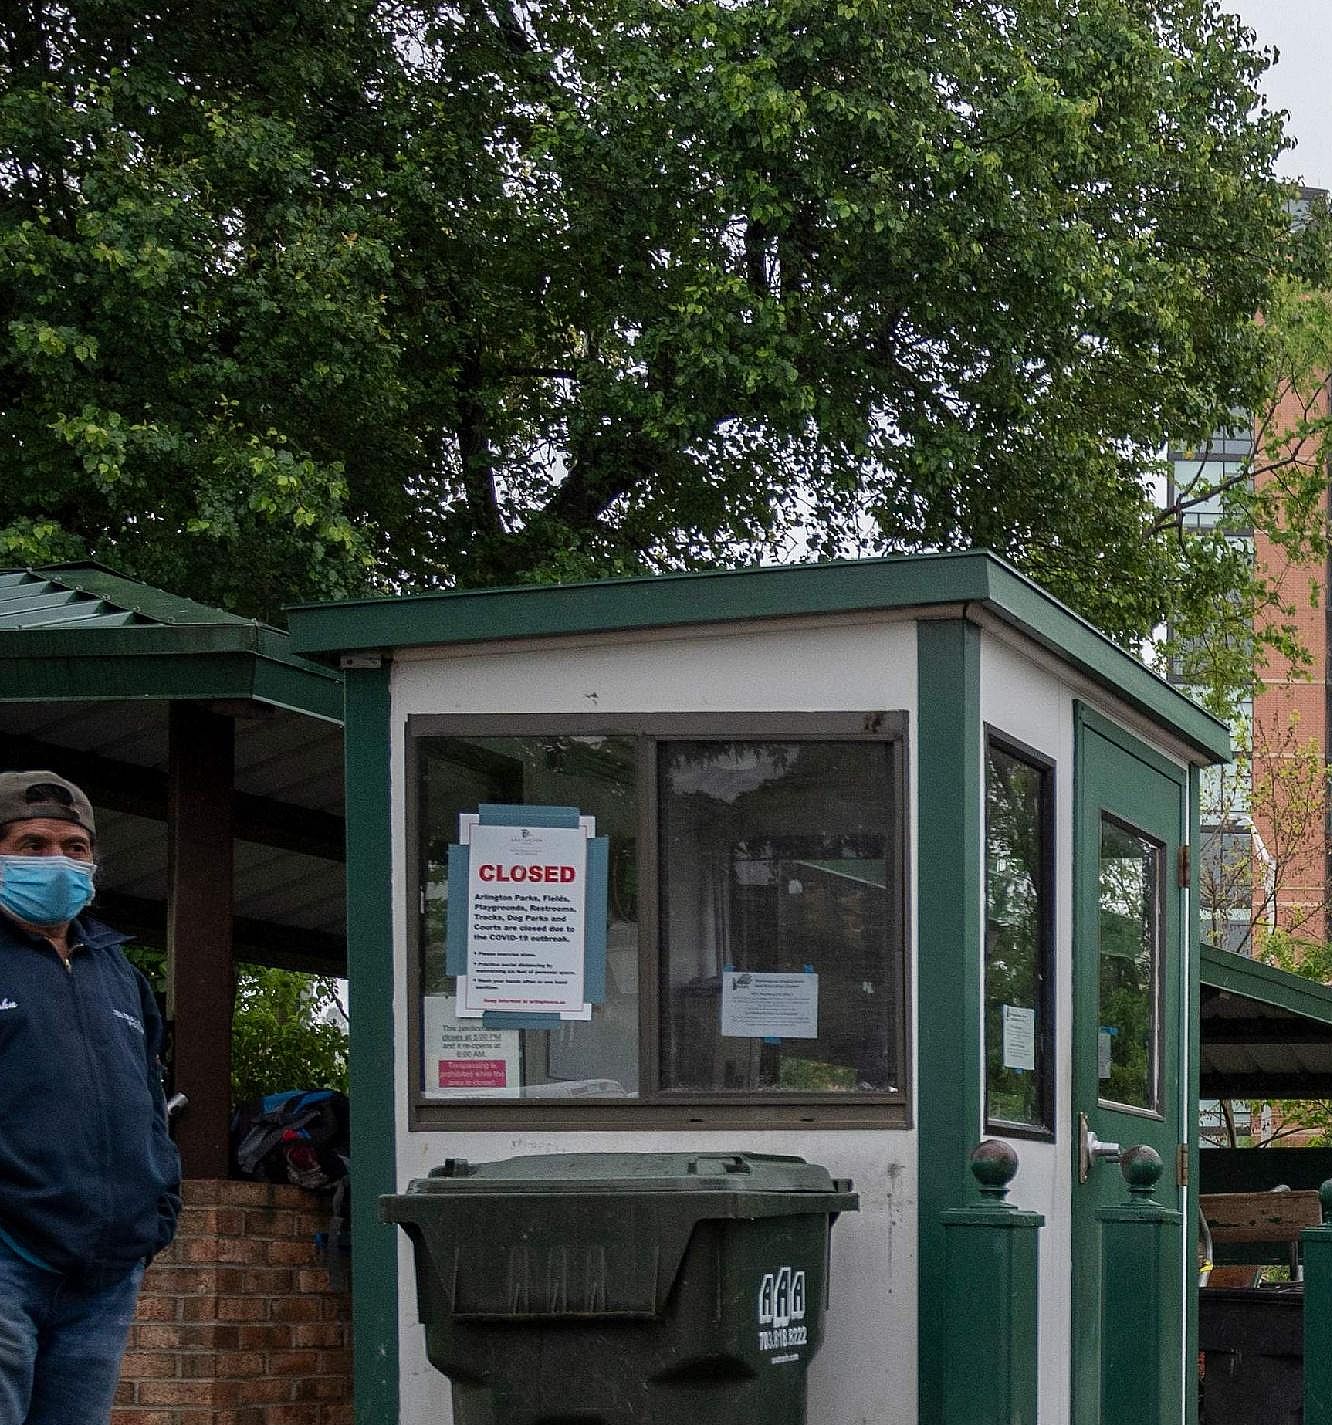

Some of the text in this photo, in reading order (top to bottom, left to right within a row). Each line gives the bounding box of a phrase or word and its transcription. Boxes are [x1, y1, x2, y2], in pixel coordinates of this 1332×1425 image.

[479, 864, 576, 883] CLOSED
[475, 894, 513, 902] Arlington
[507, 914, 523, 922] Dog
[474, 923, 501, 931] Courts
[566, 925, 576, 933] to
[490, 934, 528, 942] COVID-19
[759, 1267, 805, 1328] AAA
